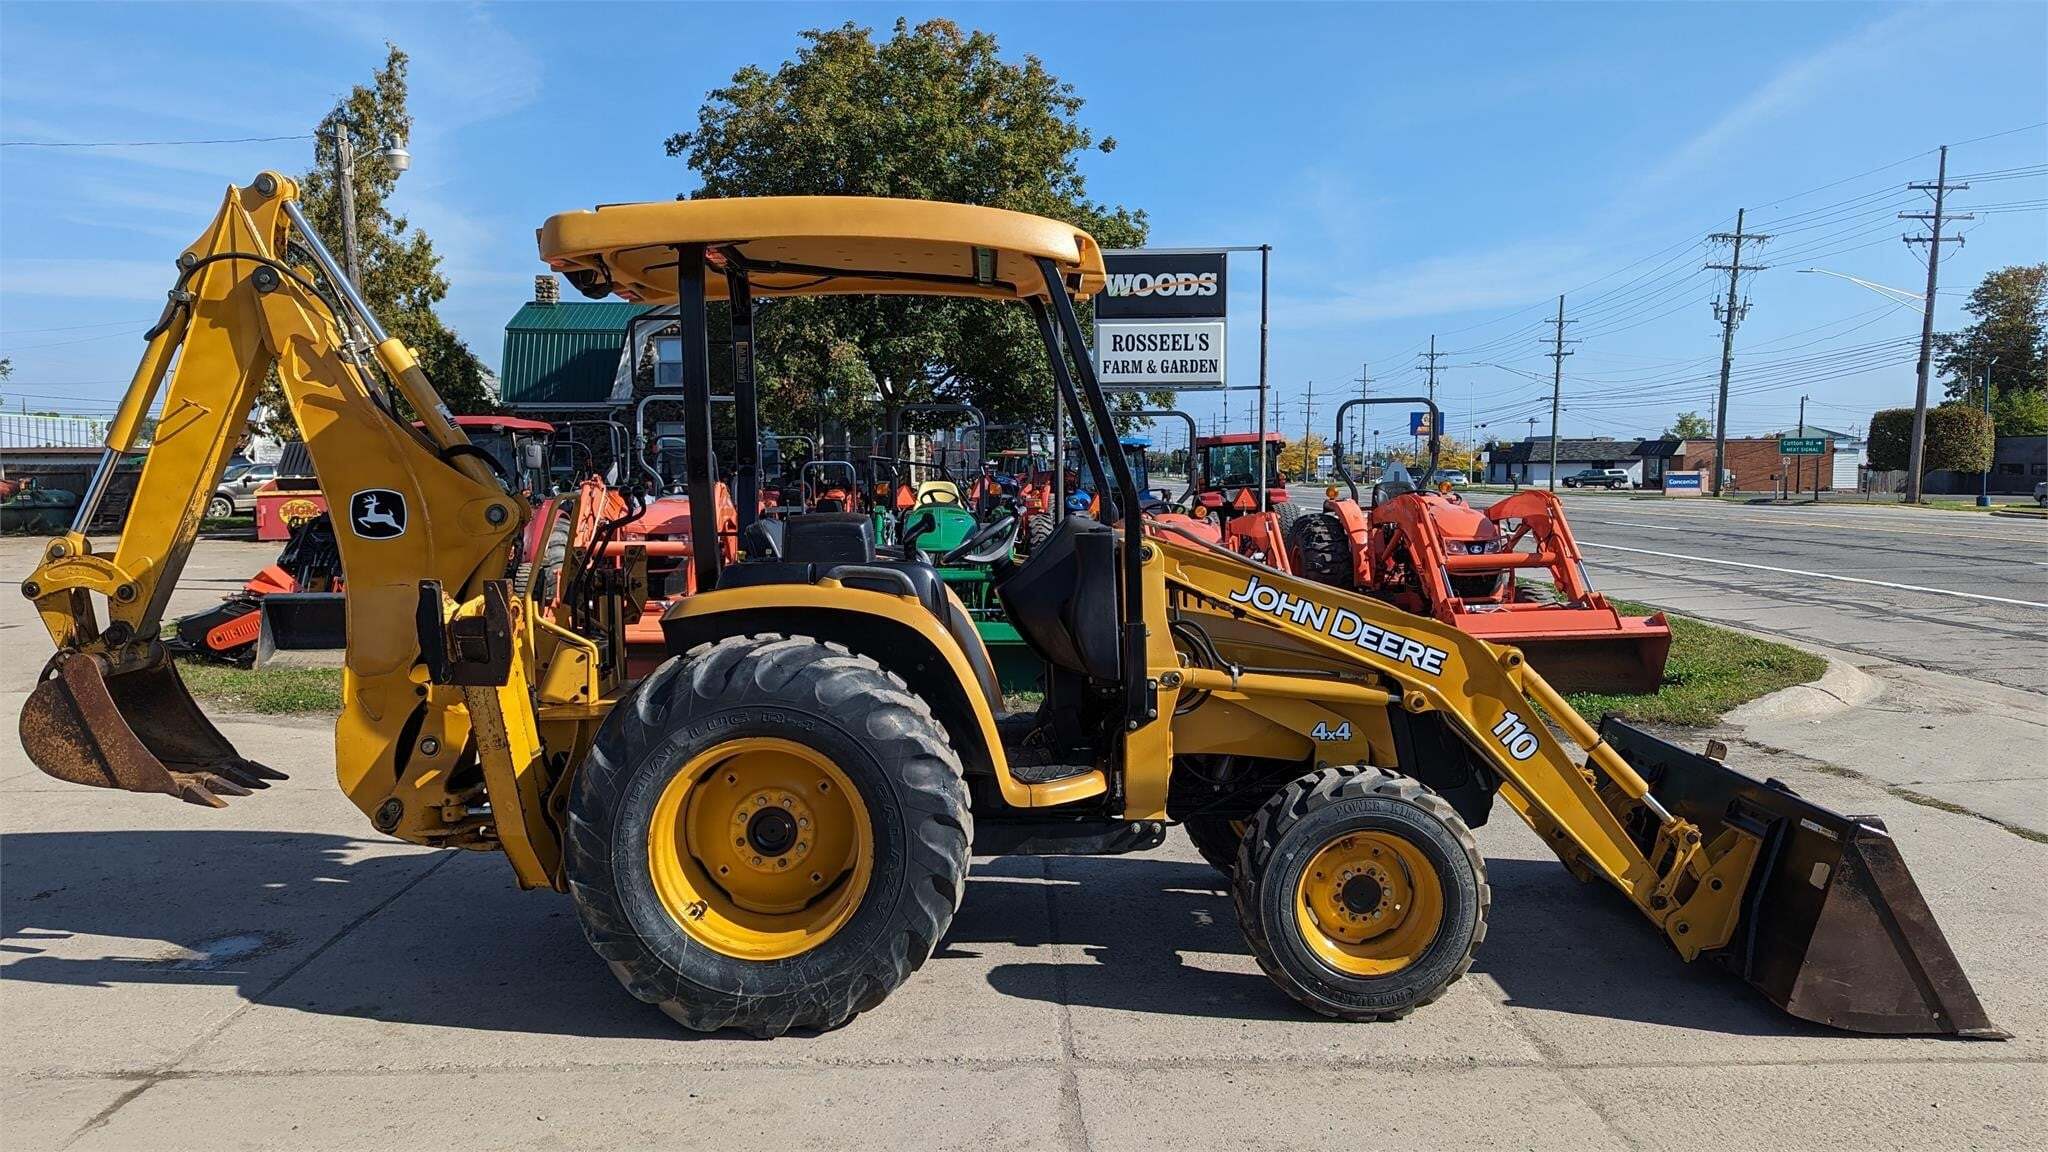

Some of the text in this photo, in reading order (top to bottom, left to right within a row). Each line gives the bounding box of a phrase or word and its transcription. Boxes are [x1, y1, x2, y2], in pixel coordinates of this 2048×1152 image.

[1106, 272, 1217, 297] WOODS
[1112, 333, 1209, 352] ROSSEEL'S
[1103, 359, 1218, 374] FARM & GARDEN
[1230, 575, 1448, 676] JOHN DEERE
[1311, 721, 1352, 741] 4x4
[1491, 711, 1540, 761] 110
